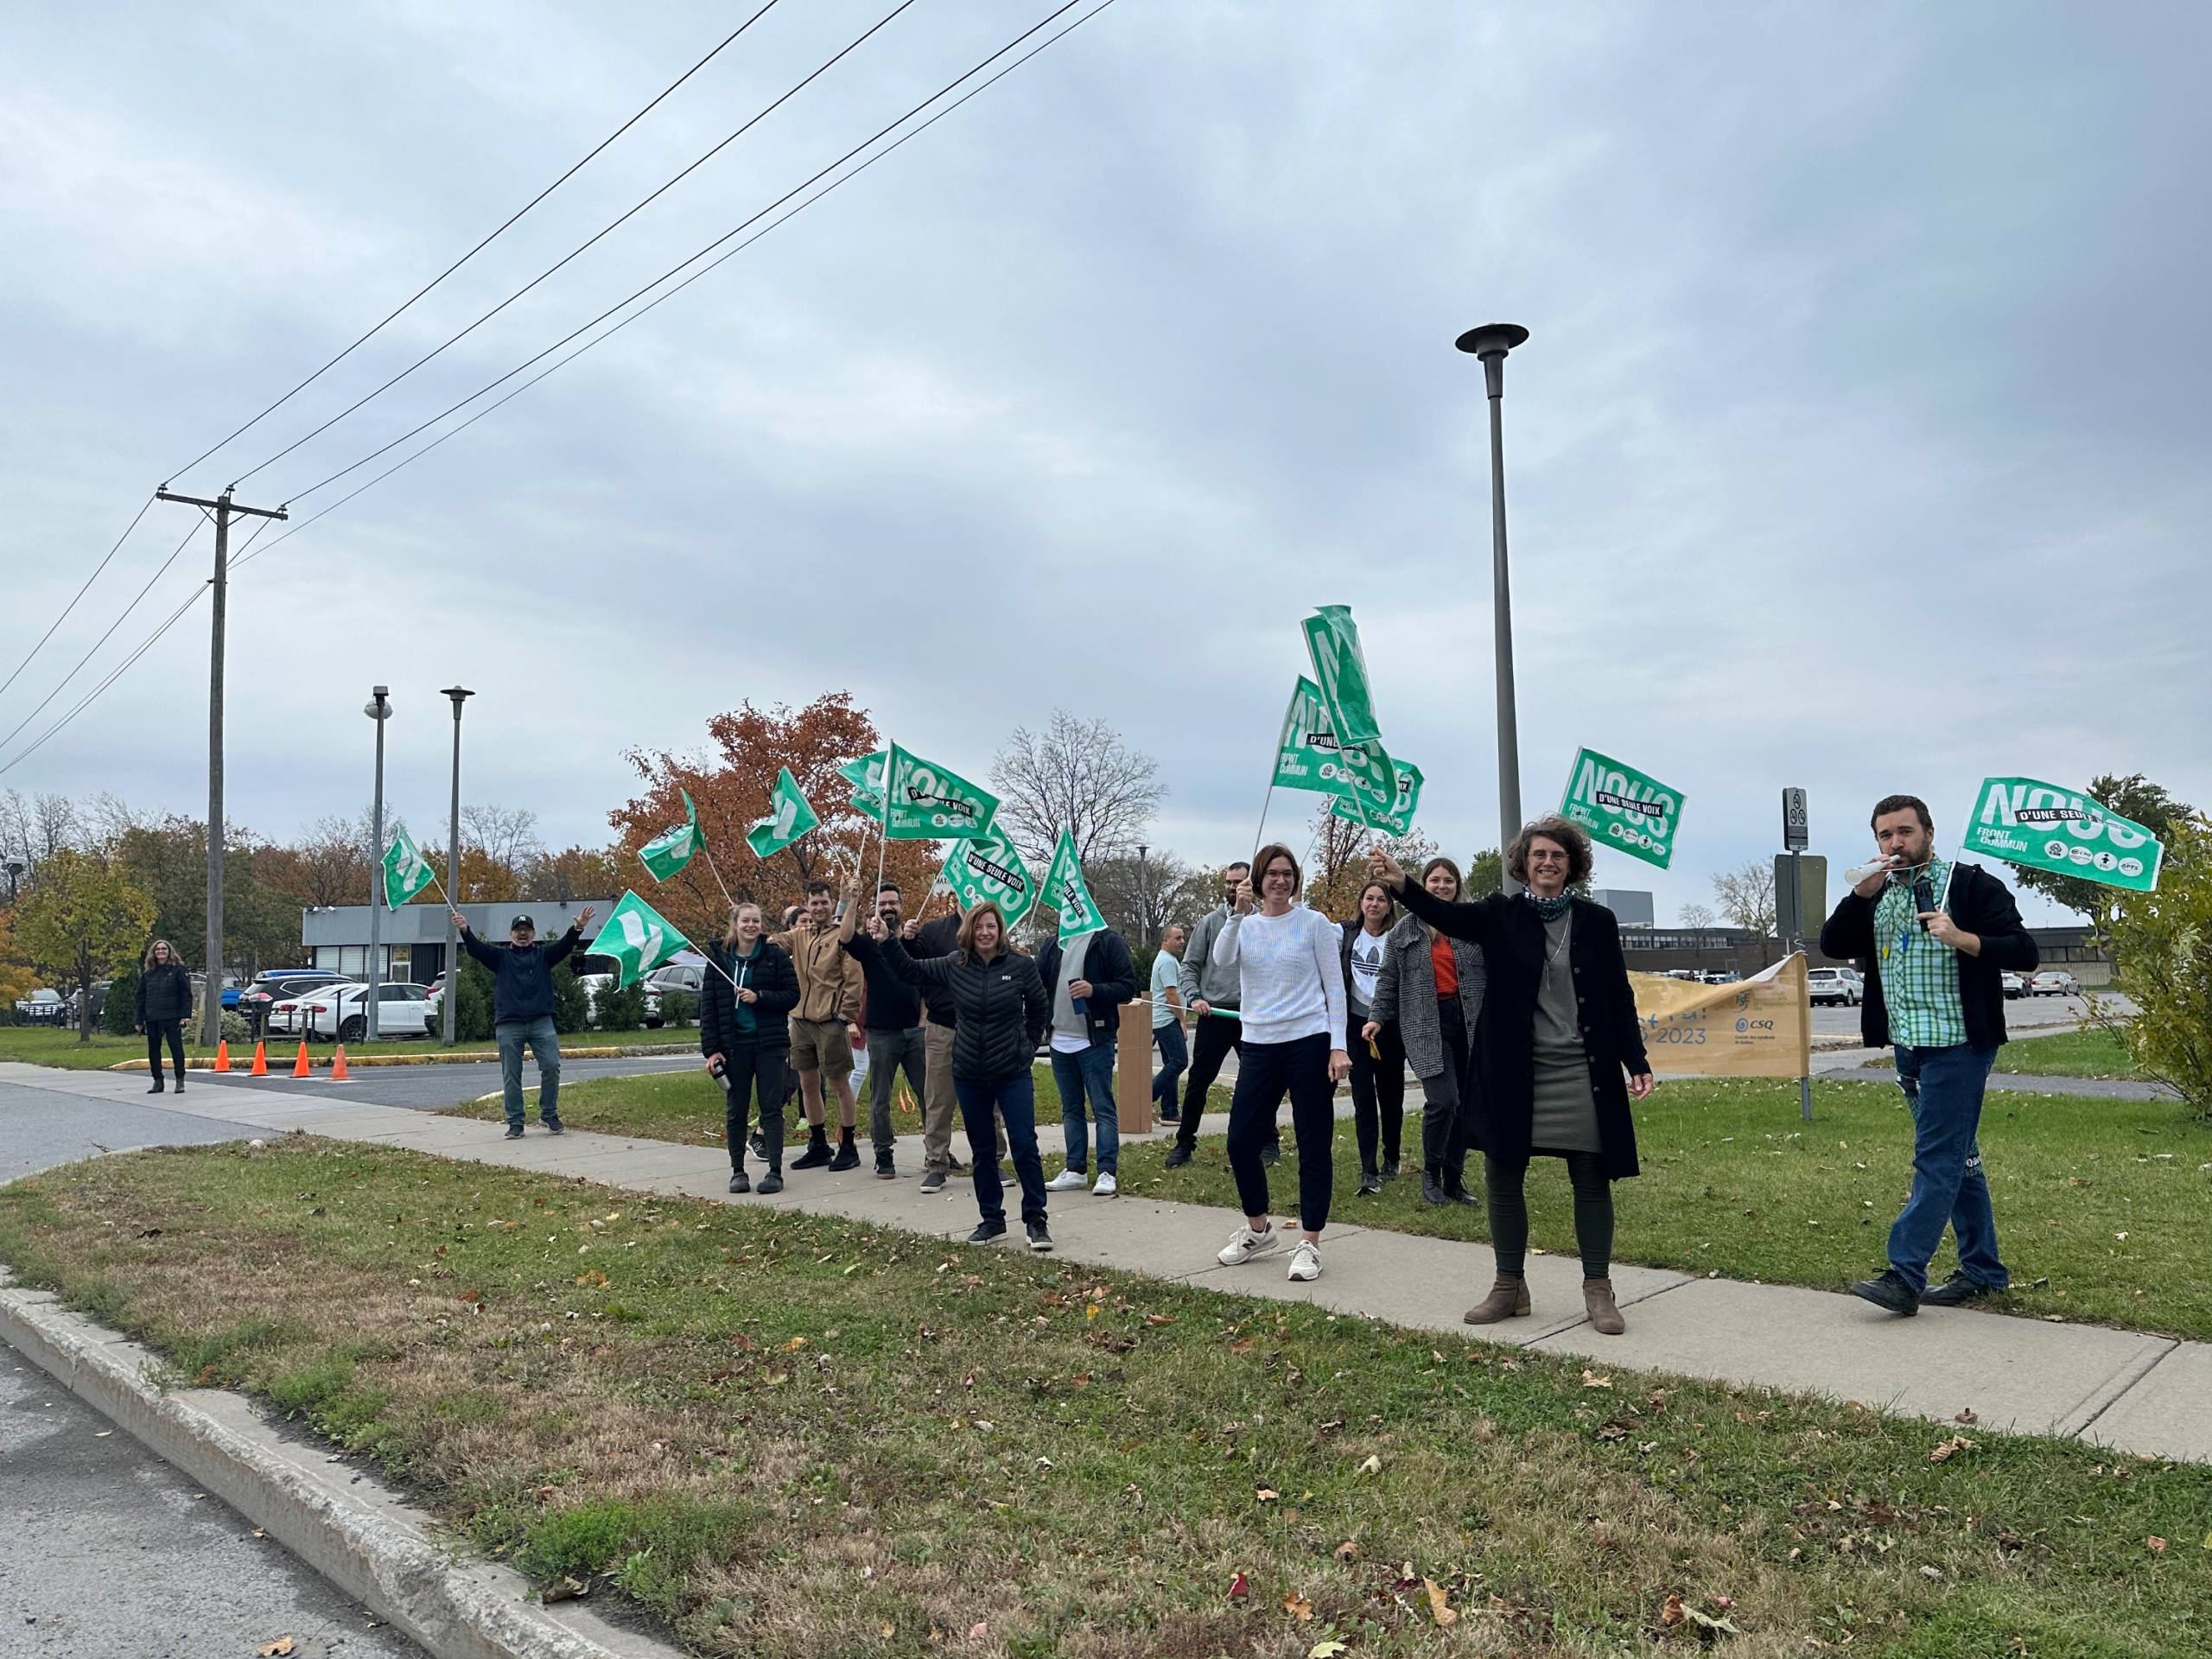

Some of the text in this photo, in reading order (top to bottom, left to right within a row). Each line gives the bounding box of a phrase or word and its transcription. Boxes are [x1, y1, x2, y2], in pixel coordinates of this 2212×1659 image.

[1573, 758, 1675, 838] NOUS
[1599, 793, 1661, 816] D'UNE SEULE VOIX
[952, 802, 971, 816] VOIX
[2019, 810, 2056, 821] D'UNE
[1977, 827, 2012, 840] FRONT
[1980, 836, 2028, 852] COMMUN
[969, 854, 987, 870] D'UNE
[987, 864, 1007, 881] SEULE
[1008, 876, 1024, 890] VOIX
[1071, 897, 1084, 917] VOIX
[1750, 1020, 1774, 1031] CSQ
[1656, 1027, 1707, 1045] 2023
